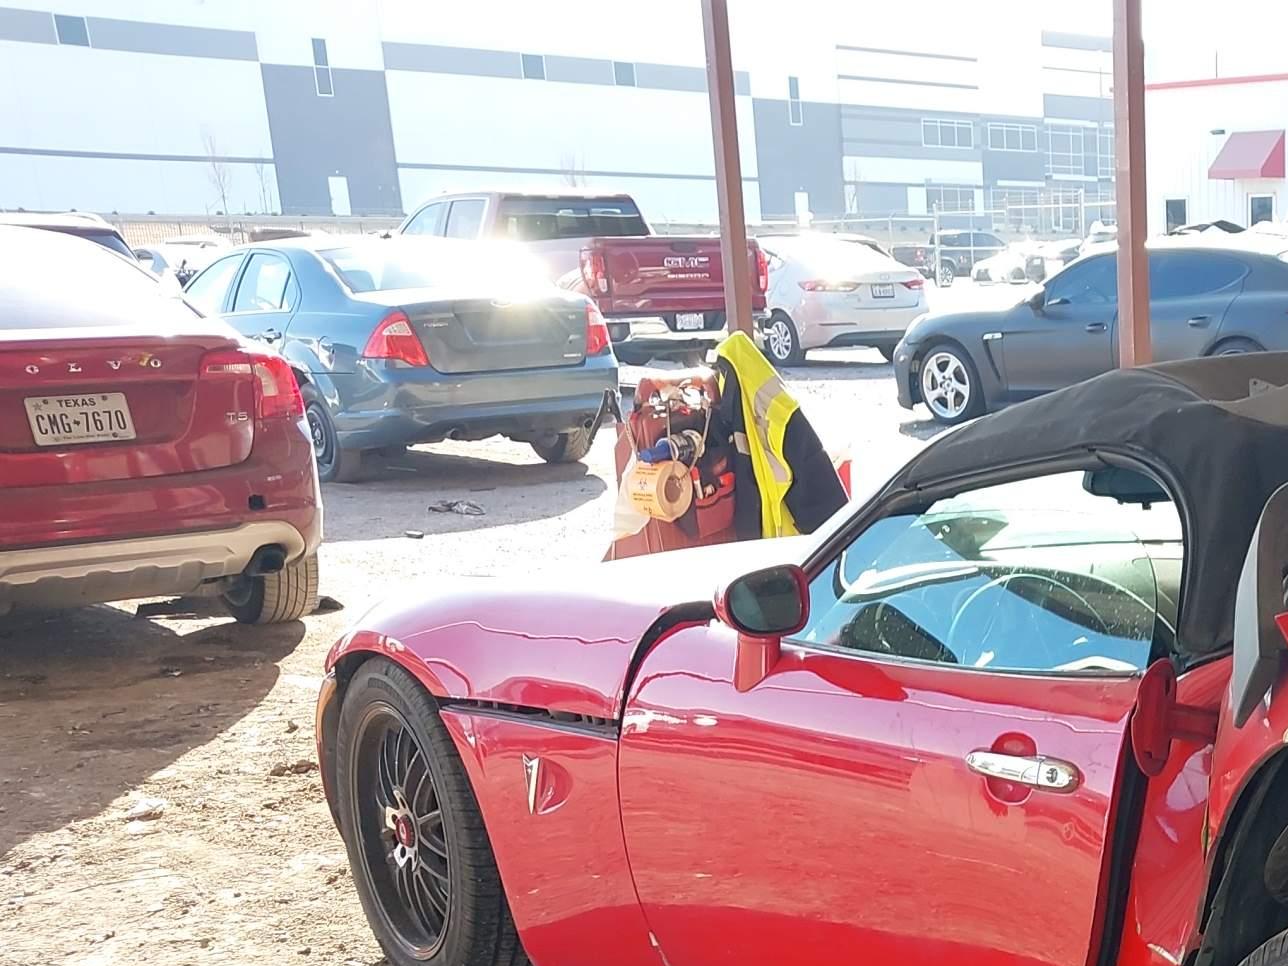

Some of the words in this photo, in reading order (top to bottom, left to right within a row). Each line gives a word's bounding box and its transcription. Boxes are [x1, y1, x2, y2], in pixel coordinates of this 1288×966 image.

[56, 397, 97, 408] TEXAS
[36, 412, 73, 435] CMG
[79, 409, 128, 433] 7670
[226, 411, 248, 425] T5
